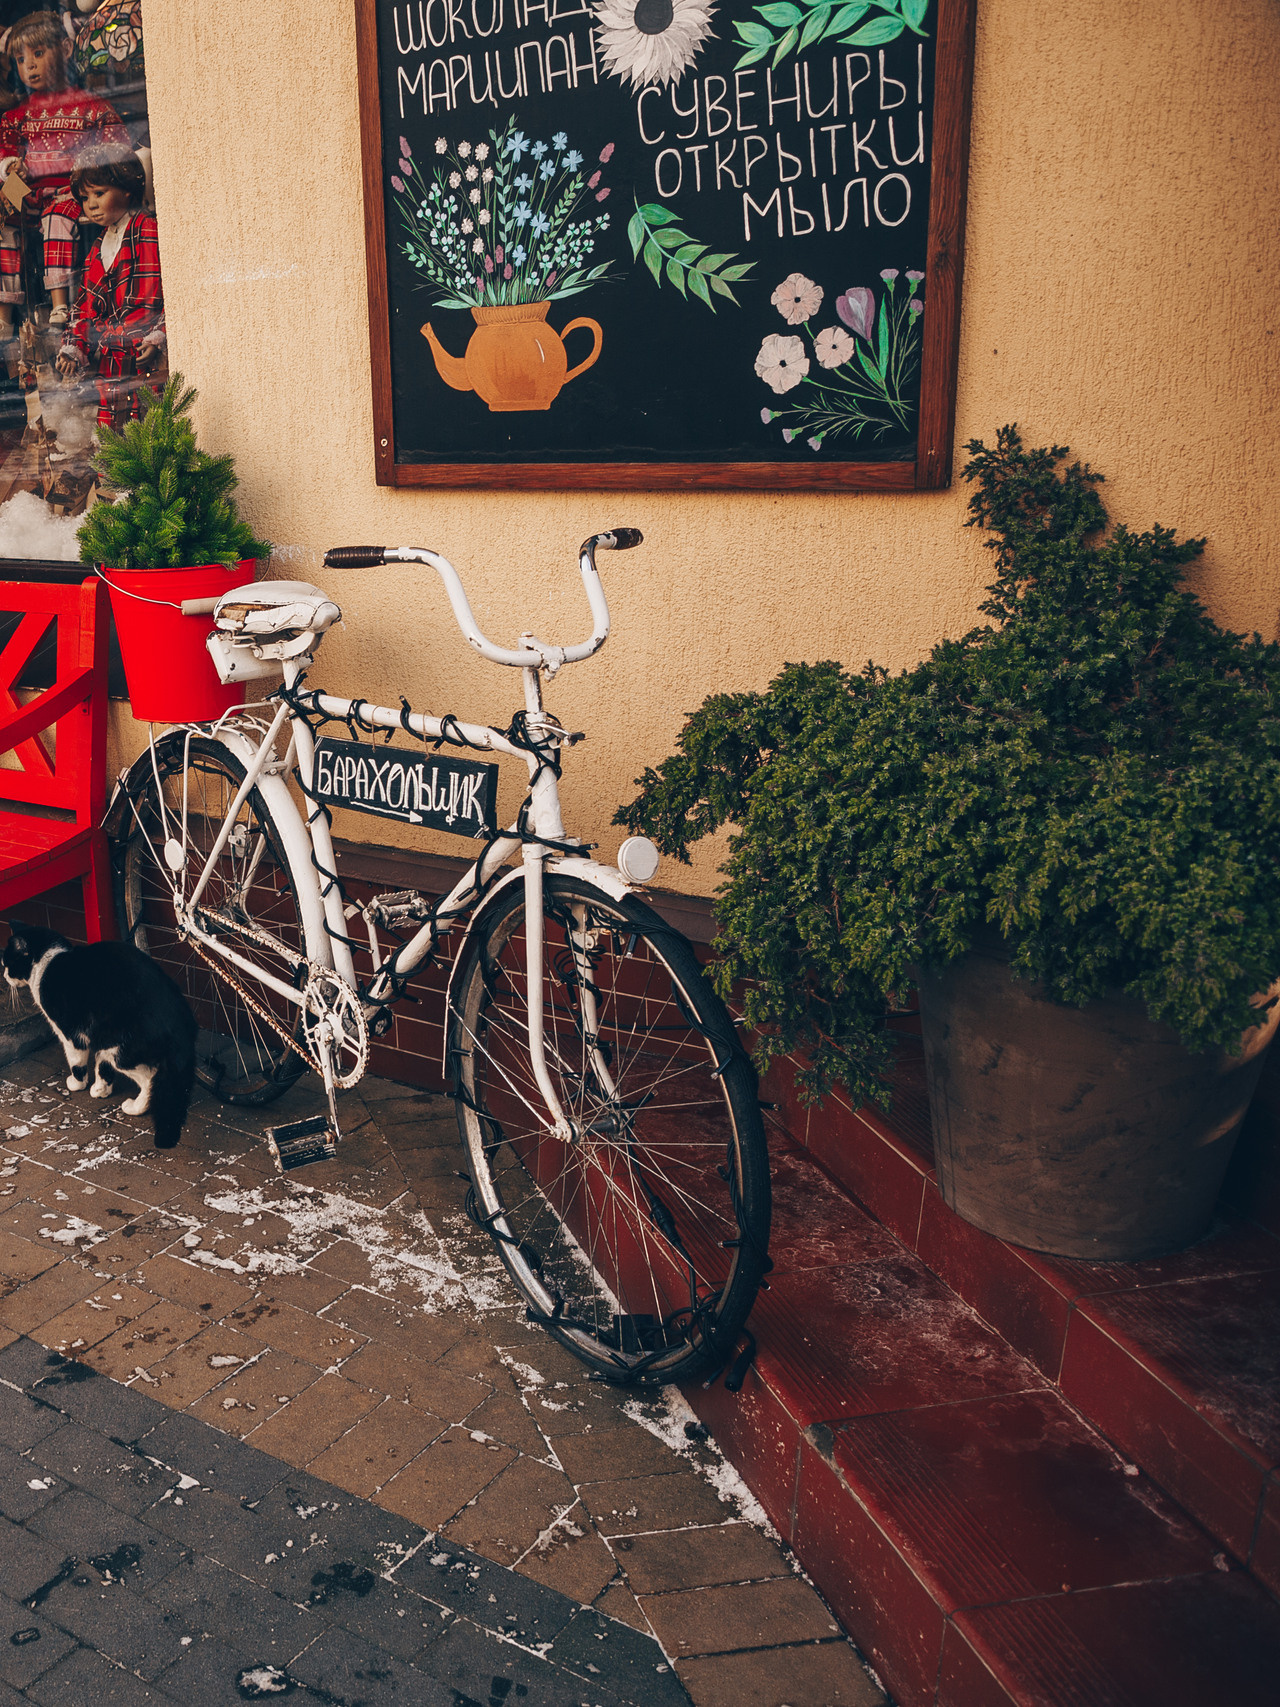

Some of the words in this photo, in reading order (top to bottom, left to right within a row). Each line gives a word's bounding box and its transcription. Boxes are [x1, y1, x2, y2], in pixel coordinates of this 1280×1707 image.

[397, 27, 598, 119] МАРЦИПАН
[637, 43, 924, 145] СУВЕНИРЫ
[655, 110, 925, 198] ОТКРЫТКИ
[742, 173, 912, 242] МЫЛО
[318, 750, 487, 826] БАРАХОЛЬЩИК
